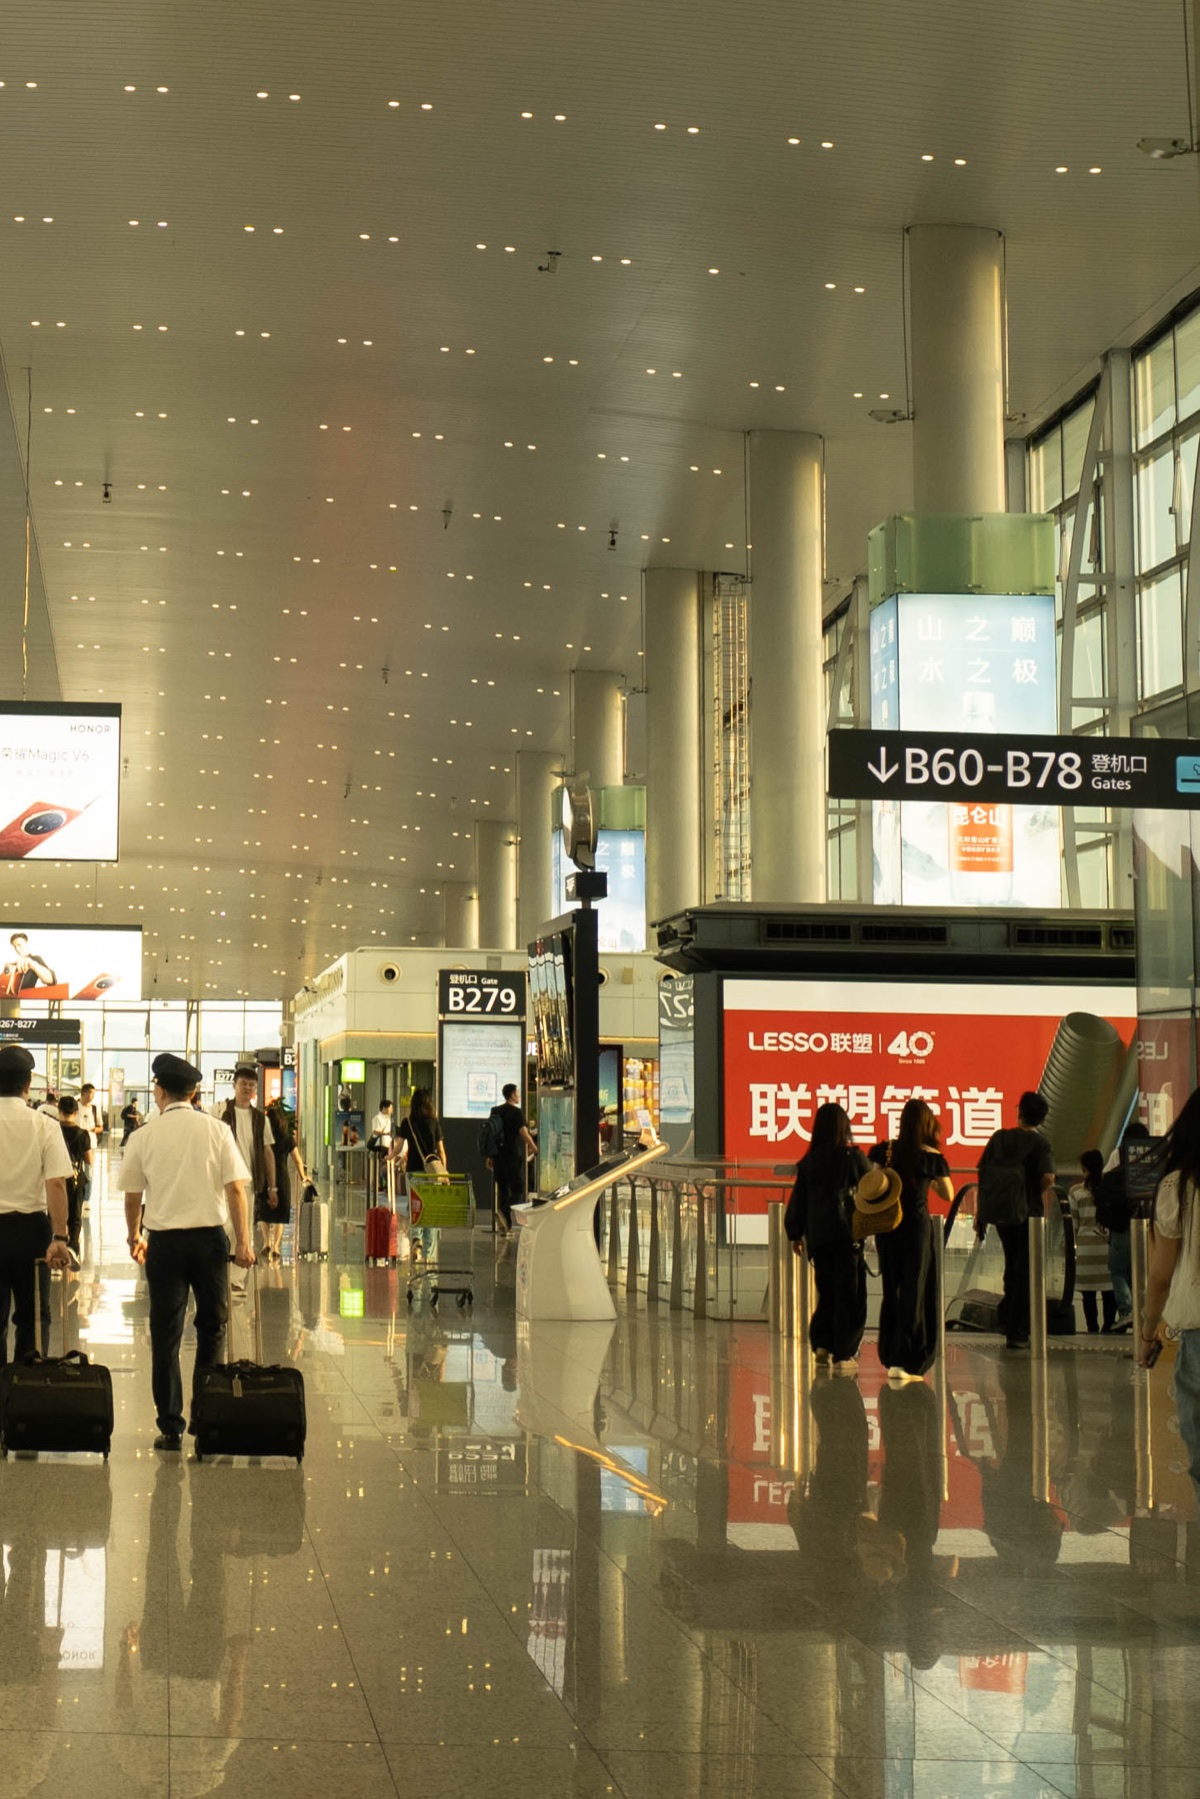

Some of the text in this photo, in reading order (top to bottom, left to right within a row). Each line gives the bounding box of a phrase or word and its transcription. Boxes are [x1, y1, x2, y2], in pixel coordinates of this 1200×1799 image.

[70, 724, 111, 734] HONOR
[904, 747, 1083, 790] B60-B78
[1091, 754, 1148, 775] 登机口
[1091, 777, 1132, 790] Gates
[481, 977, 498, 985] Gate
[449, 988, 516, 1012] B279
[748, 1030, 934, 1057] LESSO 联塑 40
